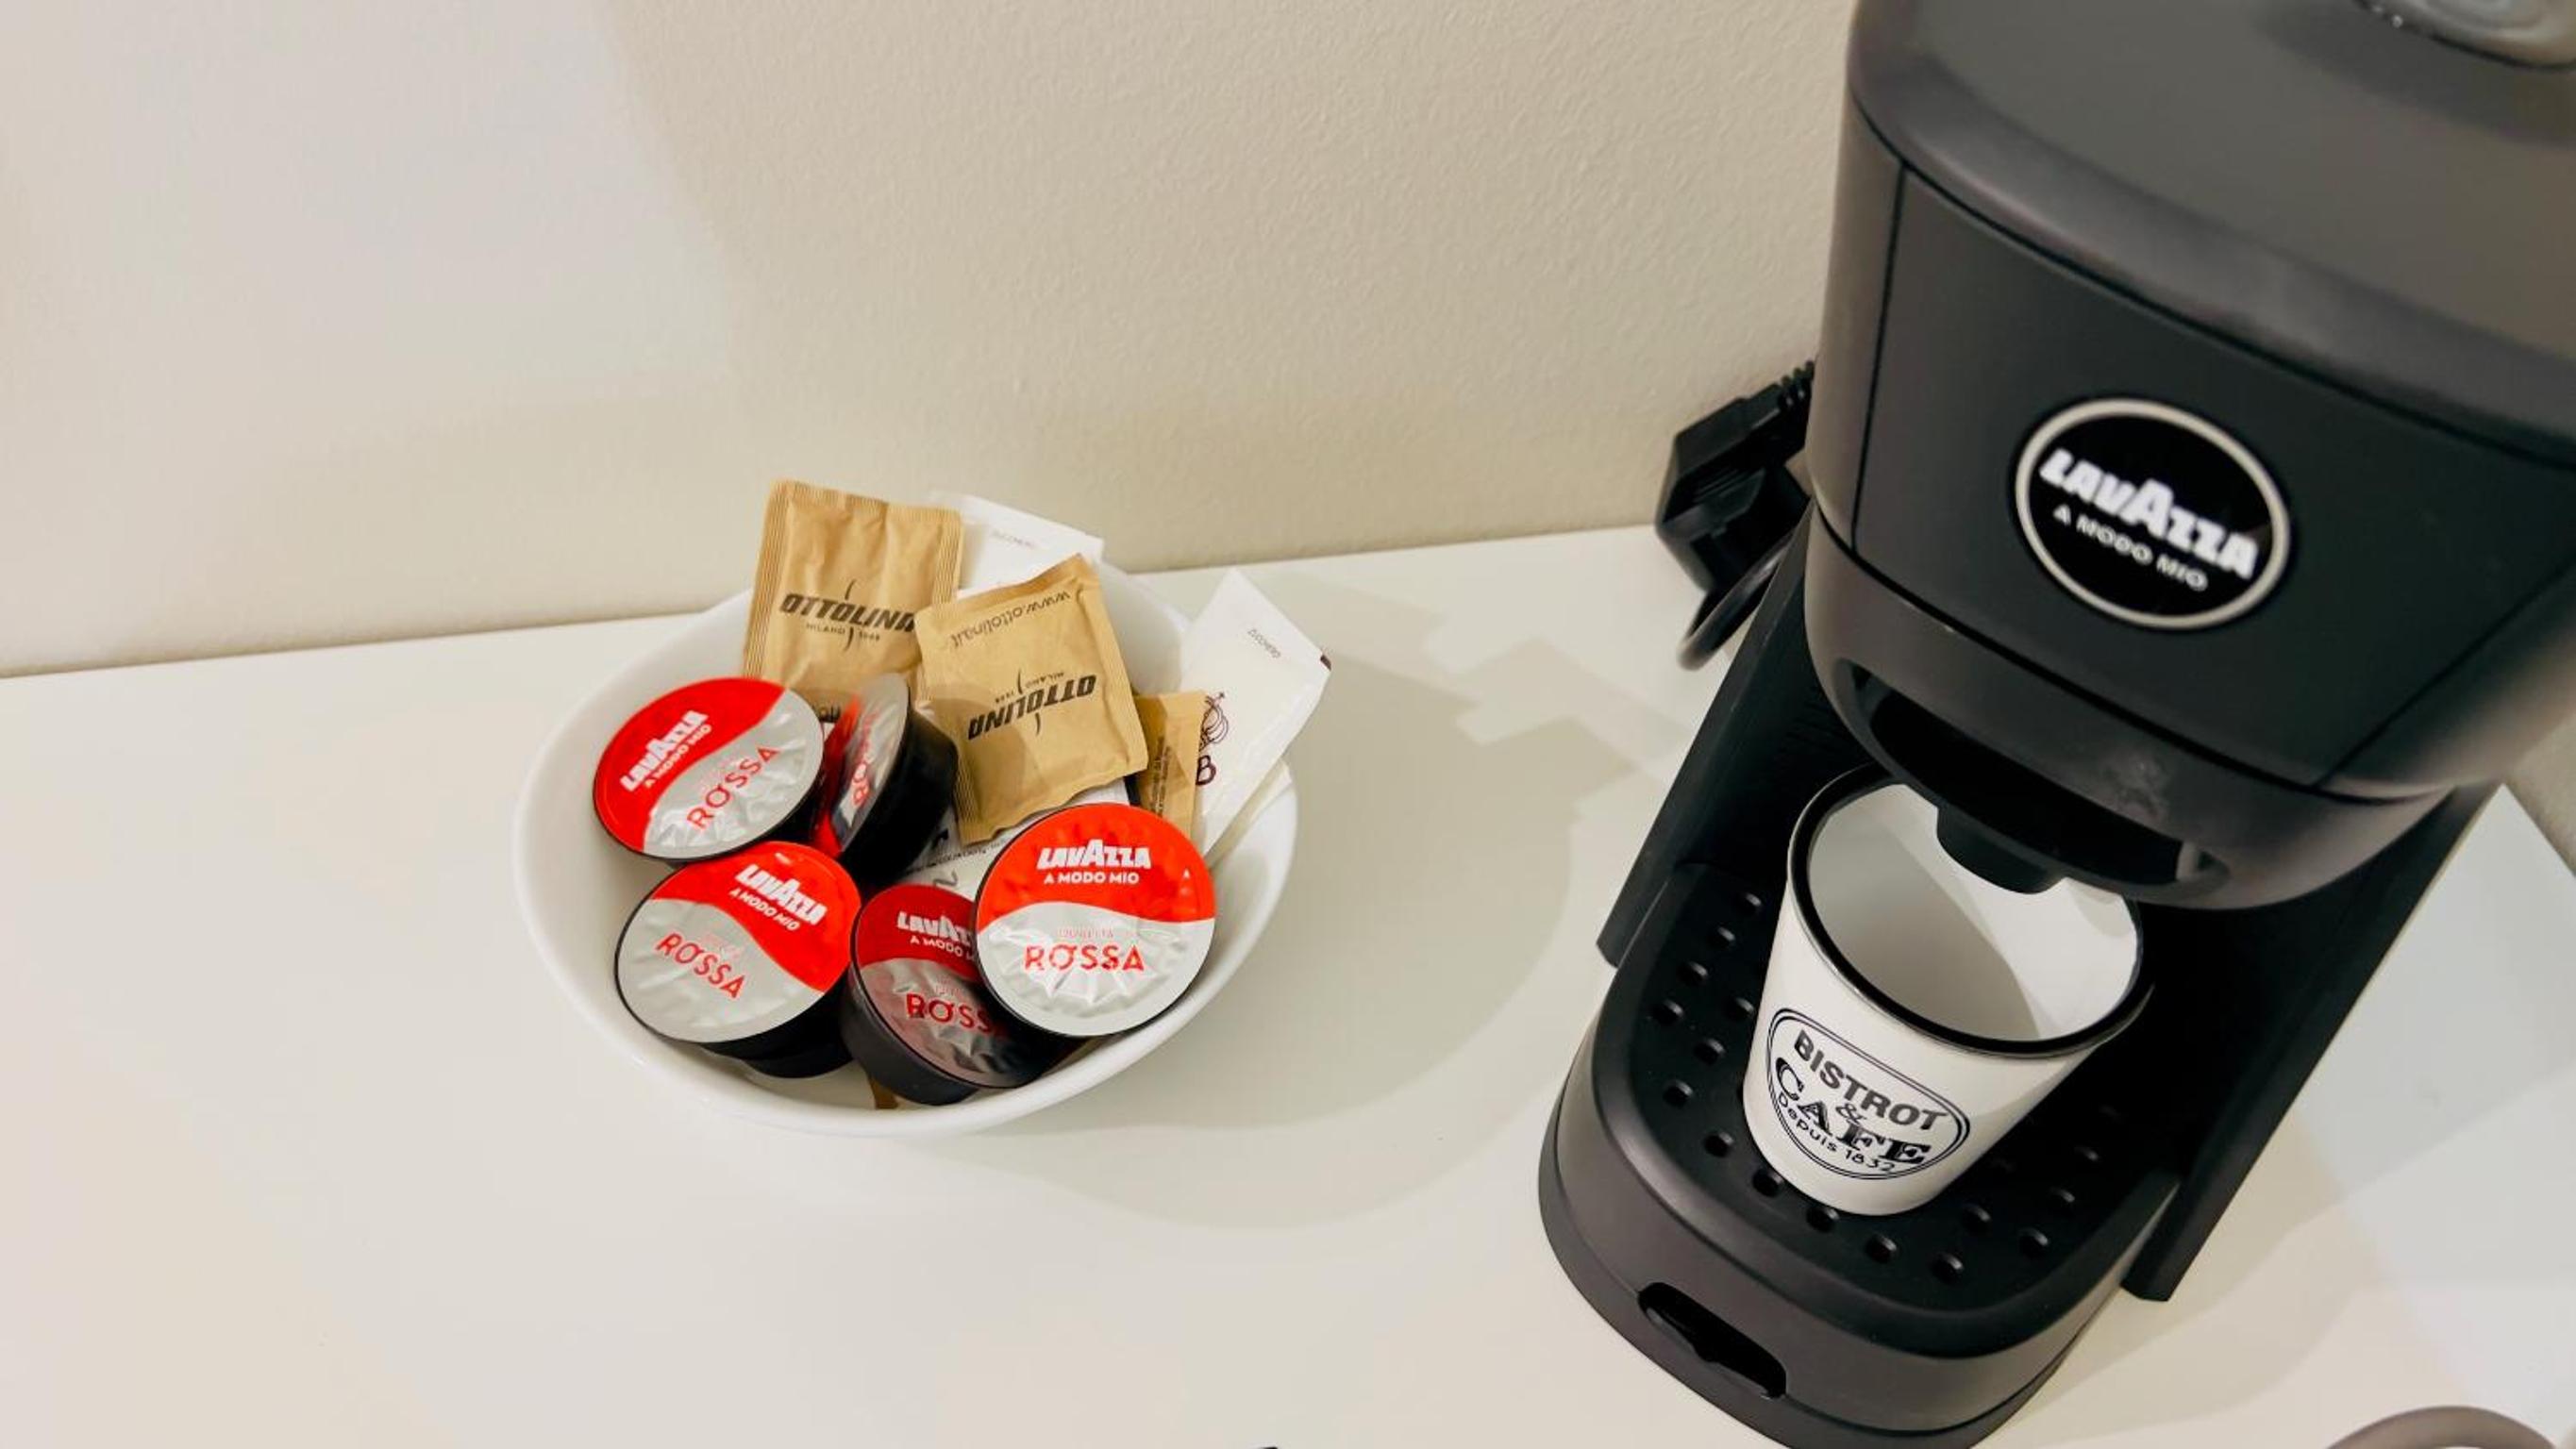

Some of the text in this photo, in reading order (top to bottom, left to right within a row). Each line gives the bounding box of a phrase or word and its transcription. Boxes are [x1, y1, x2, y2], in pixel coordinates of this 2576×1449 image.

[2039, 447, 2258, 580] LAVAZZA
[2052, 504, 2209, 591] A MODO MIO
[779, 593, 915, 633] OTTOLINA
[951, 591, 1070, 650] www.ottolina.it
[968, 675, 1096, 740] OTTOLINA
[620, 709, 709, 792] LAVAZZA
[644, 776, 656, 790] A
[652, 744, 690, 781] MODO
[688, 724, 712, 746] MIO
[1036, 839, 1152, 870] LAVAZZA
[1044, 872, 1140, 885] A MODO MIO
[729, 888, 801, 932] A MODO MIO
[734, 863, 828, 925] LAVAZZA
[896, 910, 976, 947] LAVAZ
[910, 935, 920, 945] A
[923, 937, 963, 958] MODO
[1024, 943, 1146, 973] ROSSA
[655, 932, 745, 1000] ROSSA
[906, 992, 993, 1033] ROSS
[1794, 1028, 1949, 1131] BISTROT
[1775, 1057, 1932, 1164] CAFE
[1777, 1091, 1897, 1172] Depuis 1832
[1835, 1103, 1866, 1125] &
